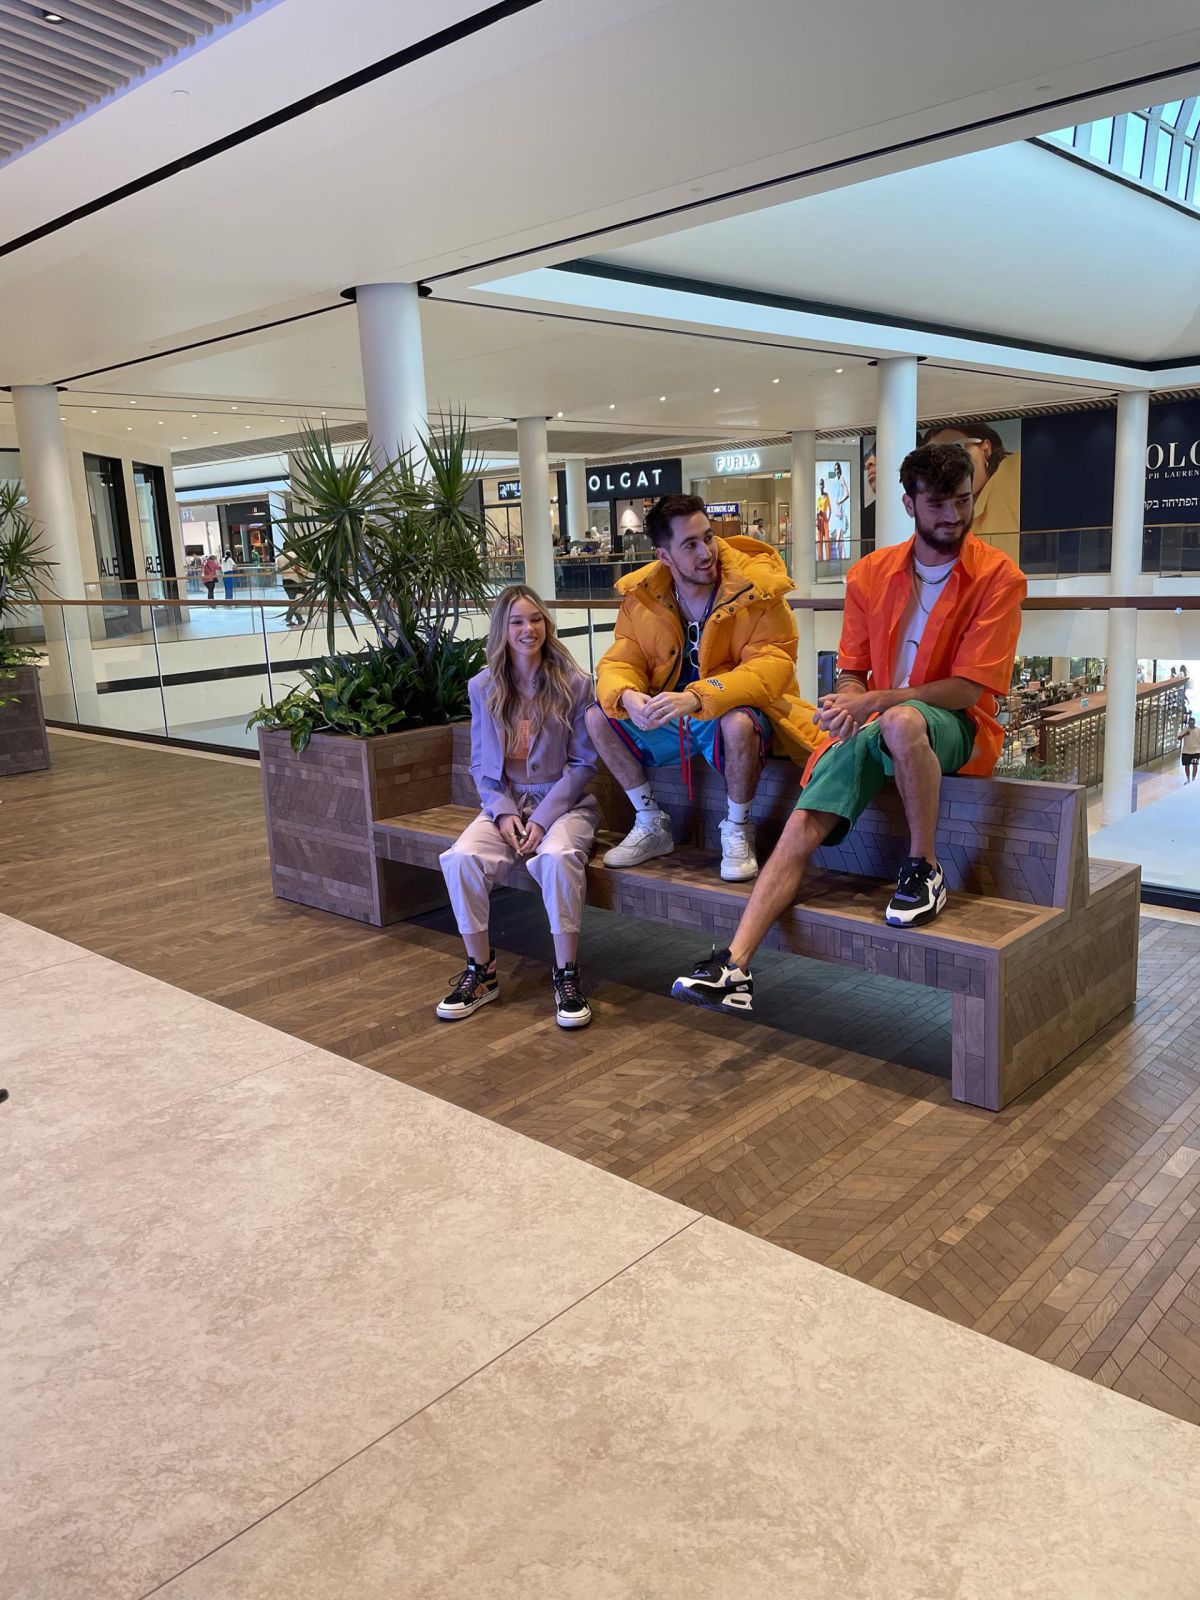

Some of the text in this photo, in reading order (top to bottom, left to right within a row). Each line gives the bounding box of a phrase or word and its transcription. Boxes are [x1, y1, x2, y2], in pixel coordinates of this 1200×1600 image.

[716, 452, 760, 472] FURLA
[1145, 440, 1200, 470] OLO
[588, 469, 662, 491] OLGAT
[1162, 497, 1198, 508] הפתיחה
[100, 557, 120, 577] ALE
